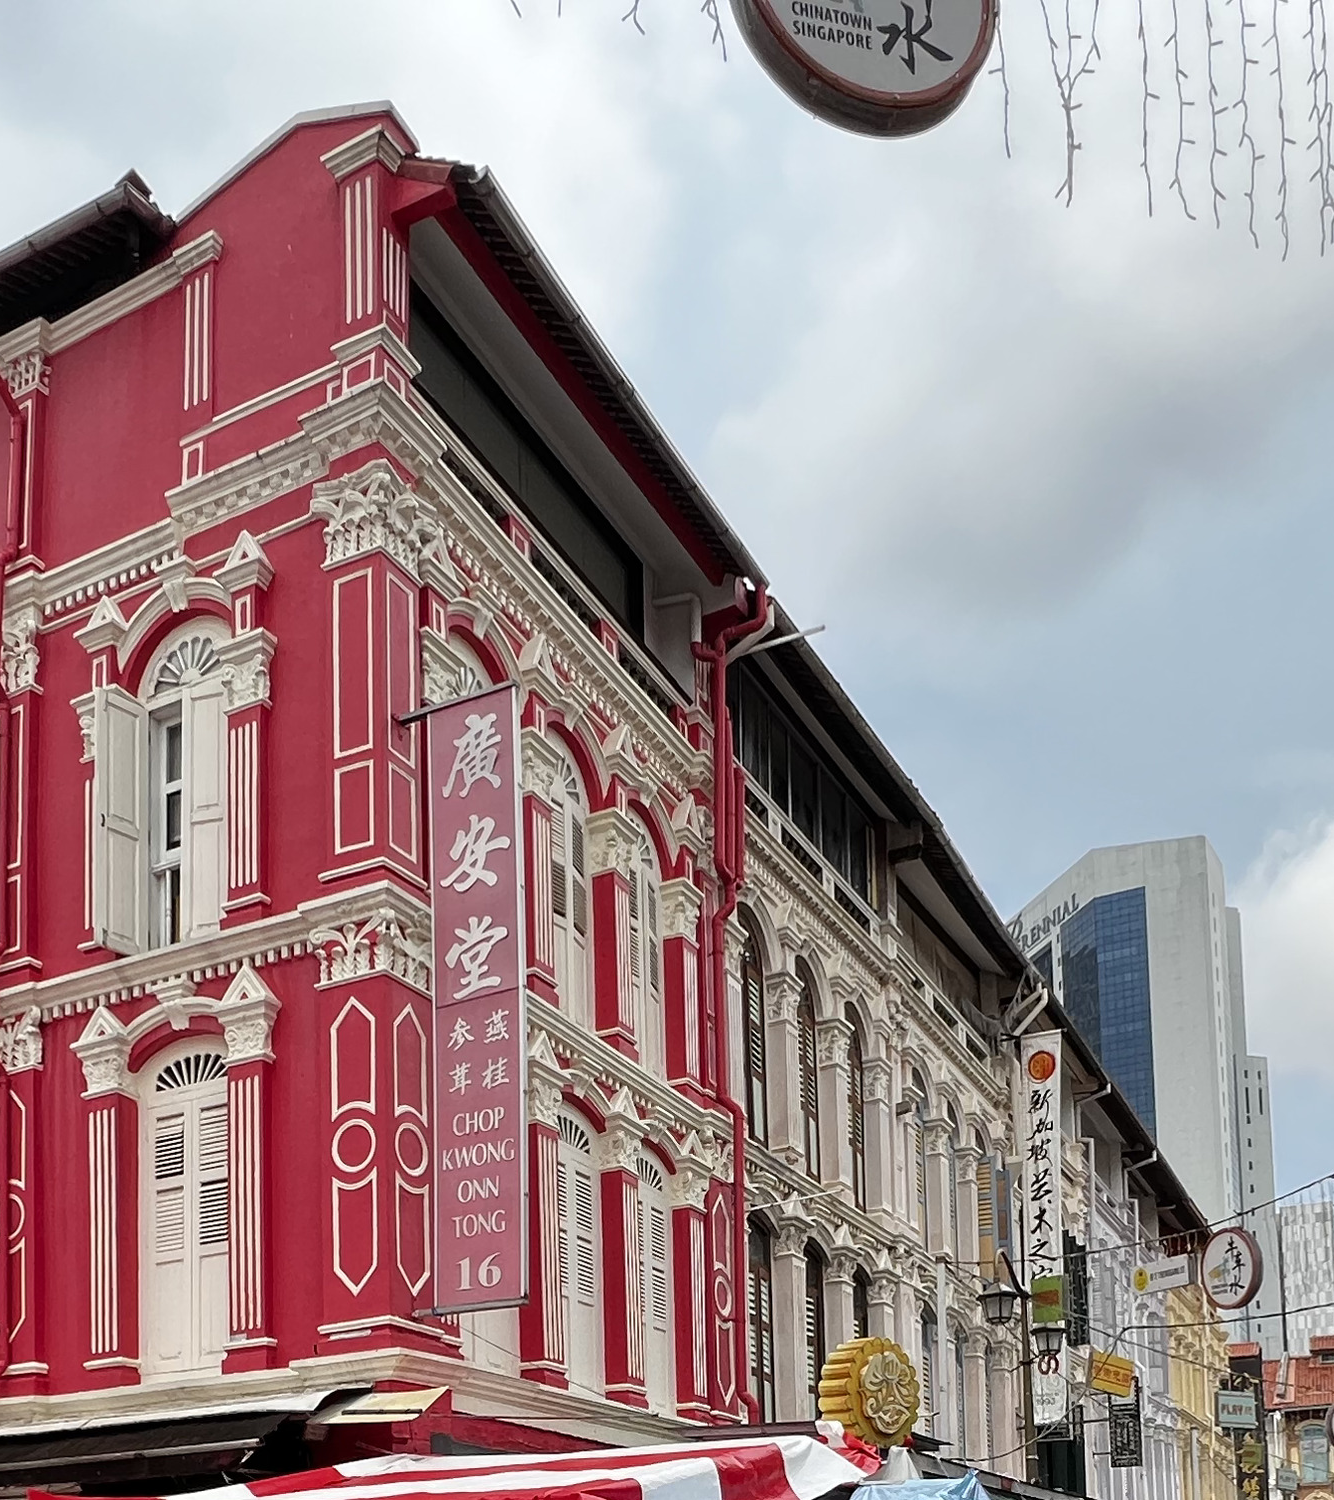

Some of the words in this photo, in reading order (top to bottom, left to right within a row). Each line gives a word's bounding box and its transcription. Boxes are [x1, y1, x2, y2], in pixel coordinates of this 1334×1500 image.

[791, 1, 873, 32] CHINATOWN
[792, 20, 873, 50] SINGAPORE
[441, 713, 512, 1002] 廣安堂
[451, 1105, 505, 1136] CHOP
[441, 1136, 516, 1170] KWONG
[457, 1176, 501, 1203] ONN
[451, 1211, 506, 1239] TONG
[454, 1251, 503, 1292] 16
